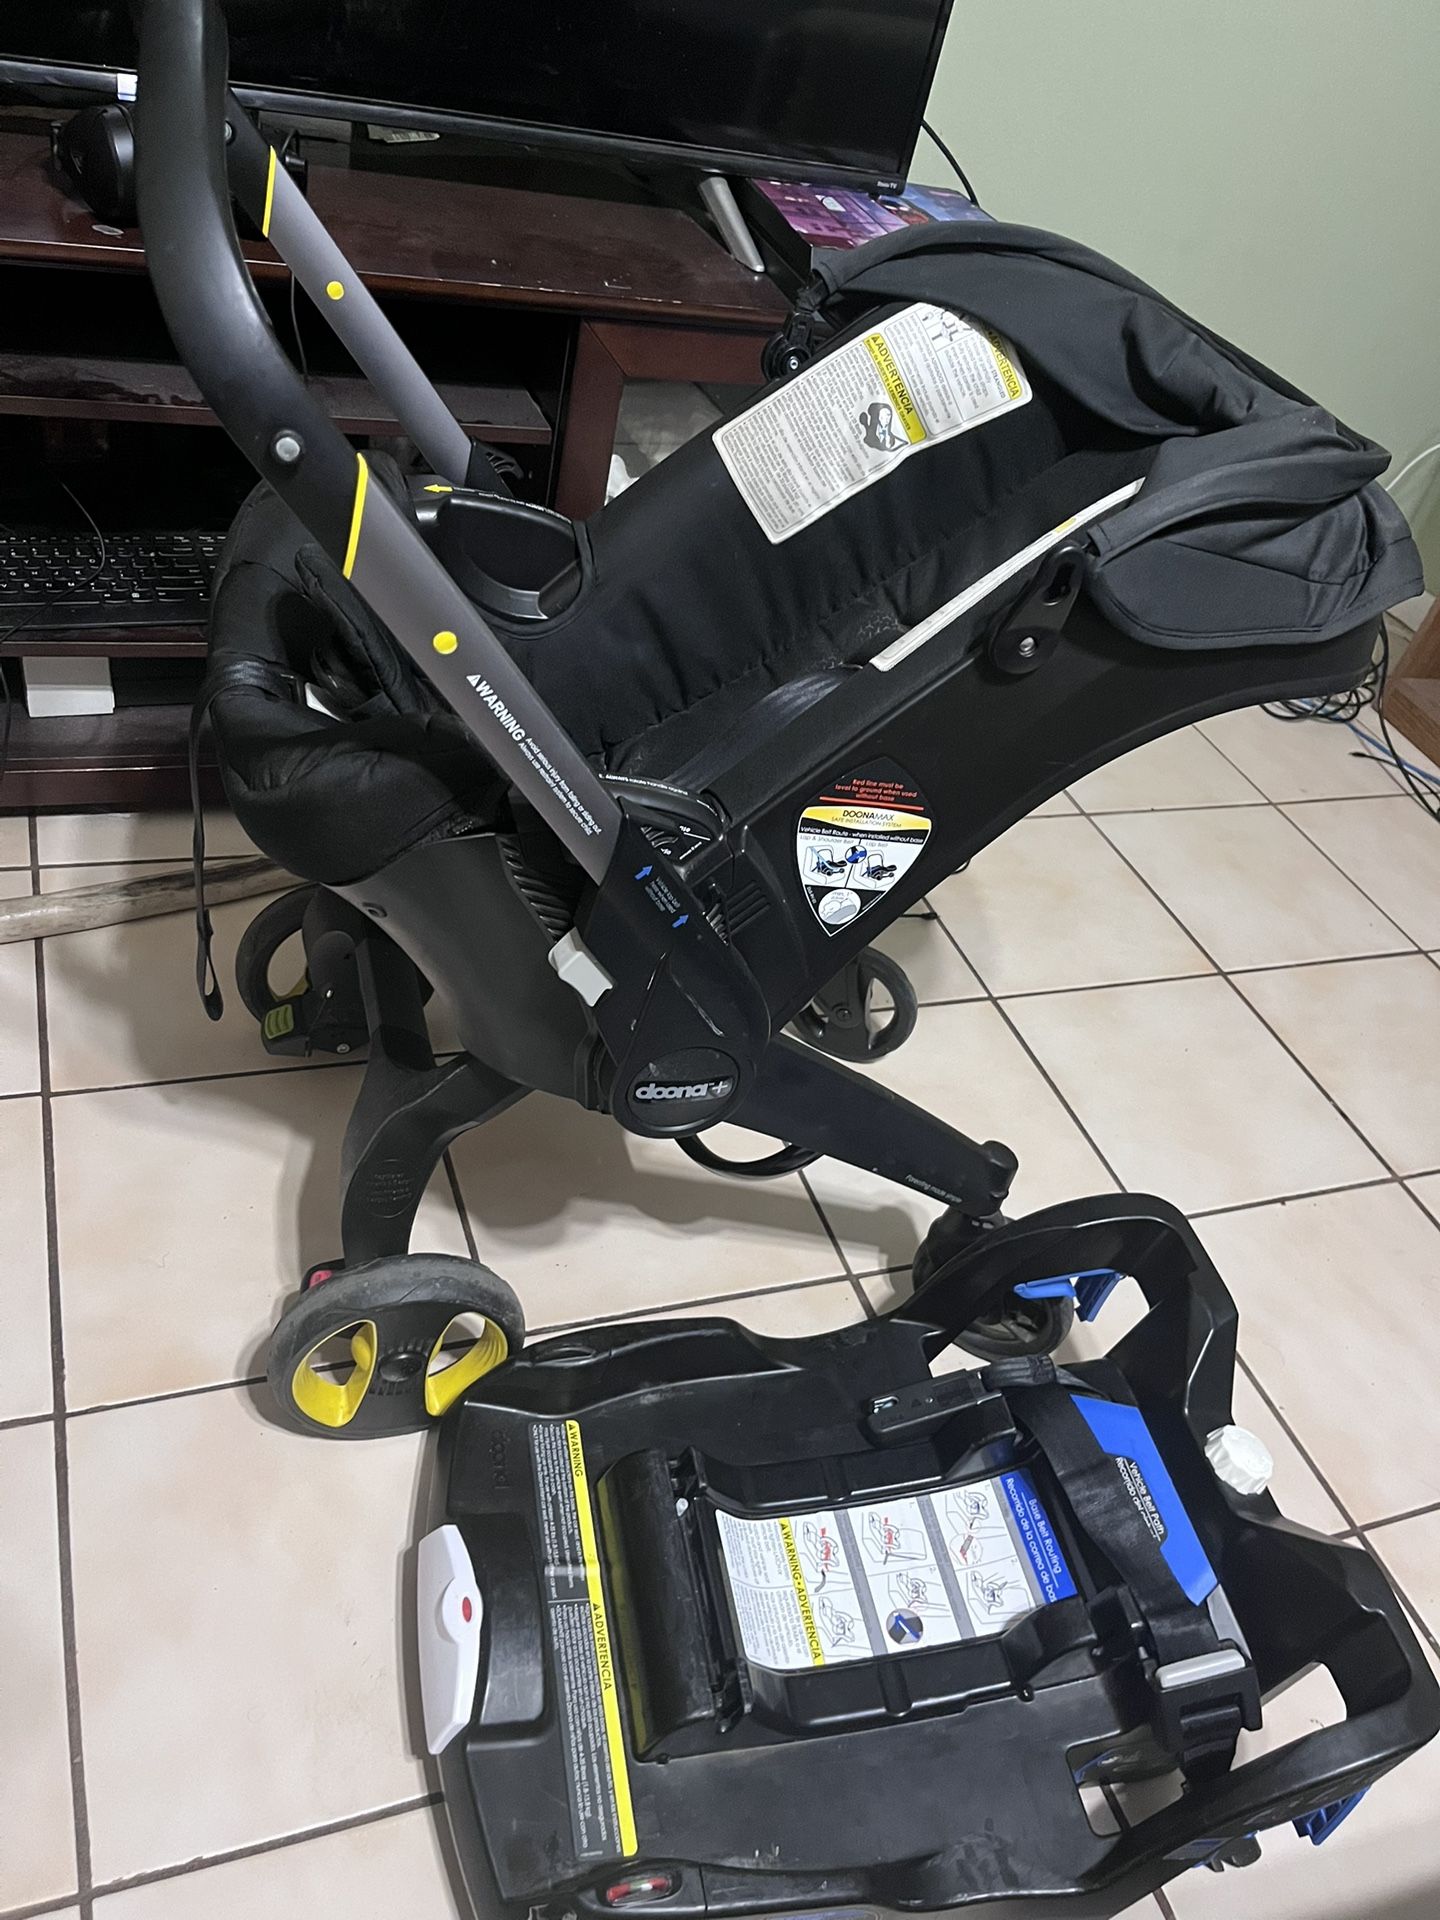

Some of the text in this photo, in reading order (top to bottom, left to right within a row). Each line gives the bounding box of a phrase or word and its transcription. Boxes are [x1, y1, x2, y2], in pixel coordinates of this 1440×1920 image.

[875, 341, 914, 414] ADVERTENCIA
[988, 332, 1020, 397] ADVERTENCIA
[474, 679, 526, 742] WARNING
[525, 736, 540, 754] Avoid
[842, 809, 894, 821] DOONAMAX
[569, 1431, 583, 1477] WARNING
[1113, 1455, 1138, 1497] Recorrido
[1004, 1477, 1026, 1518] Recorrido
[1128, 1461, 1148, 1494] Vehicle
[1142, 1494, 1156, 1513] Belt
[1150, 1512, 1165, 1534] Path
[1019, 1516, 1031, 1531] de
[1024, 1530, 1035, 1540] la
[1027, 1498, 1063, 1574] Base Belt Routing
[783, 1531, 801, 1580] WARNING
[1027, 1539, 1045, 1570] correa
[1039, 1569, 1051, 1584] de
[1044, 1584, 1058, 1602] bas
[796, 1586, 821, 1659] ADVERTENCIA
[593, 1612, 612, 1690] ADVERTENCIA
